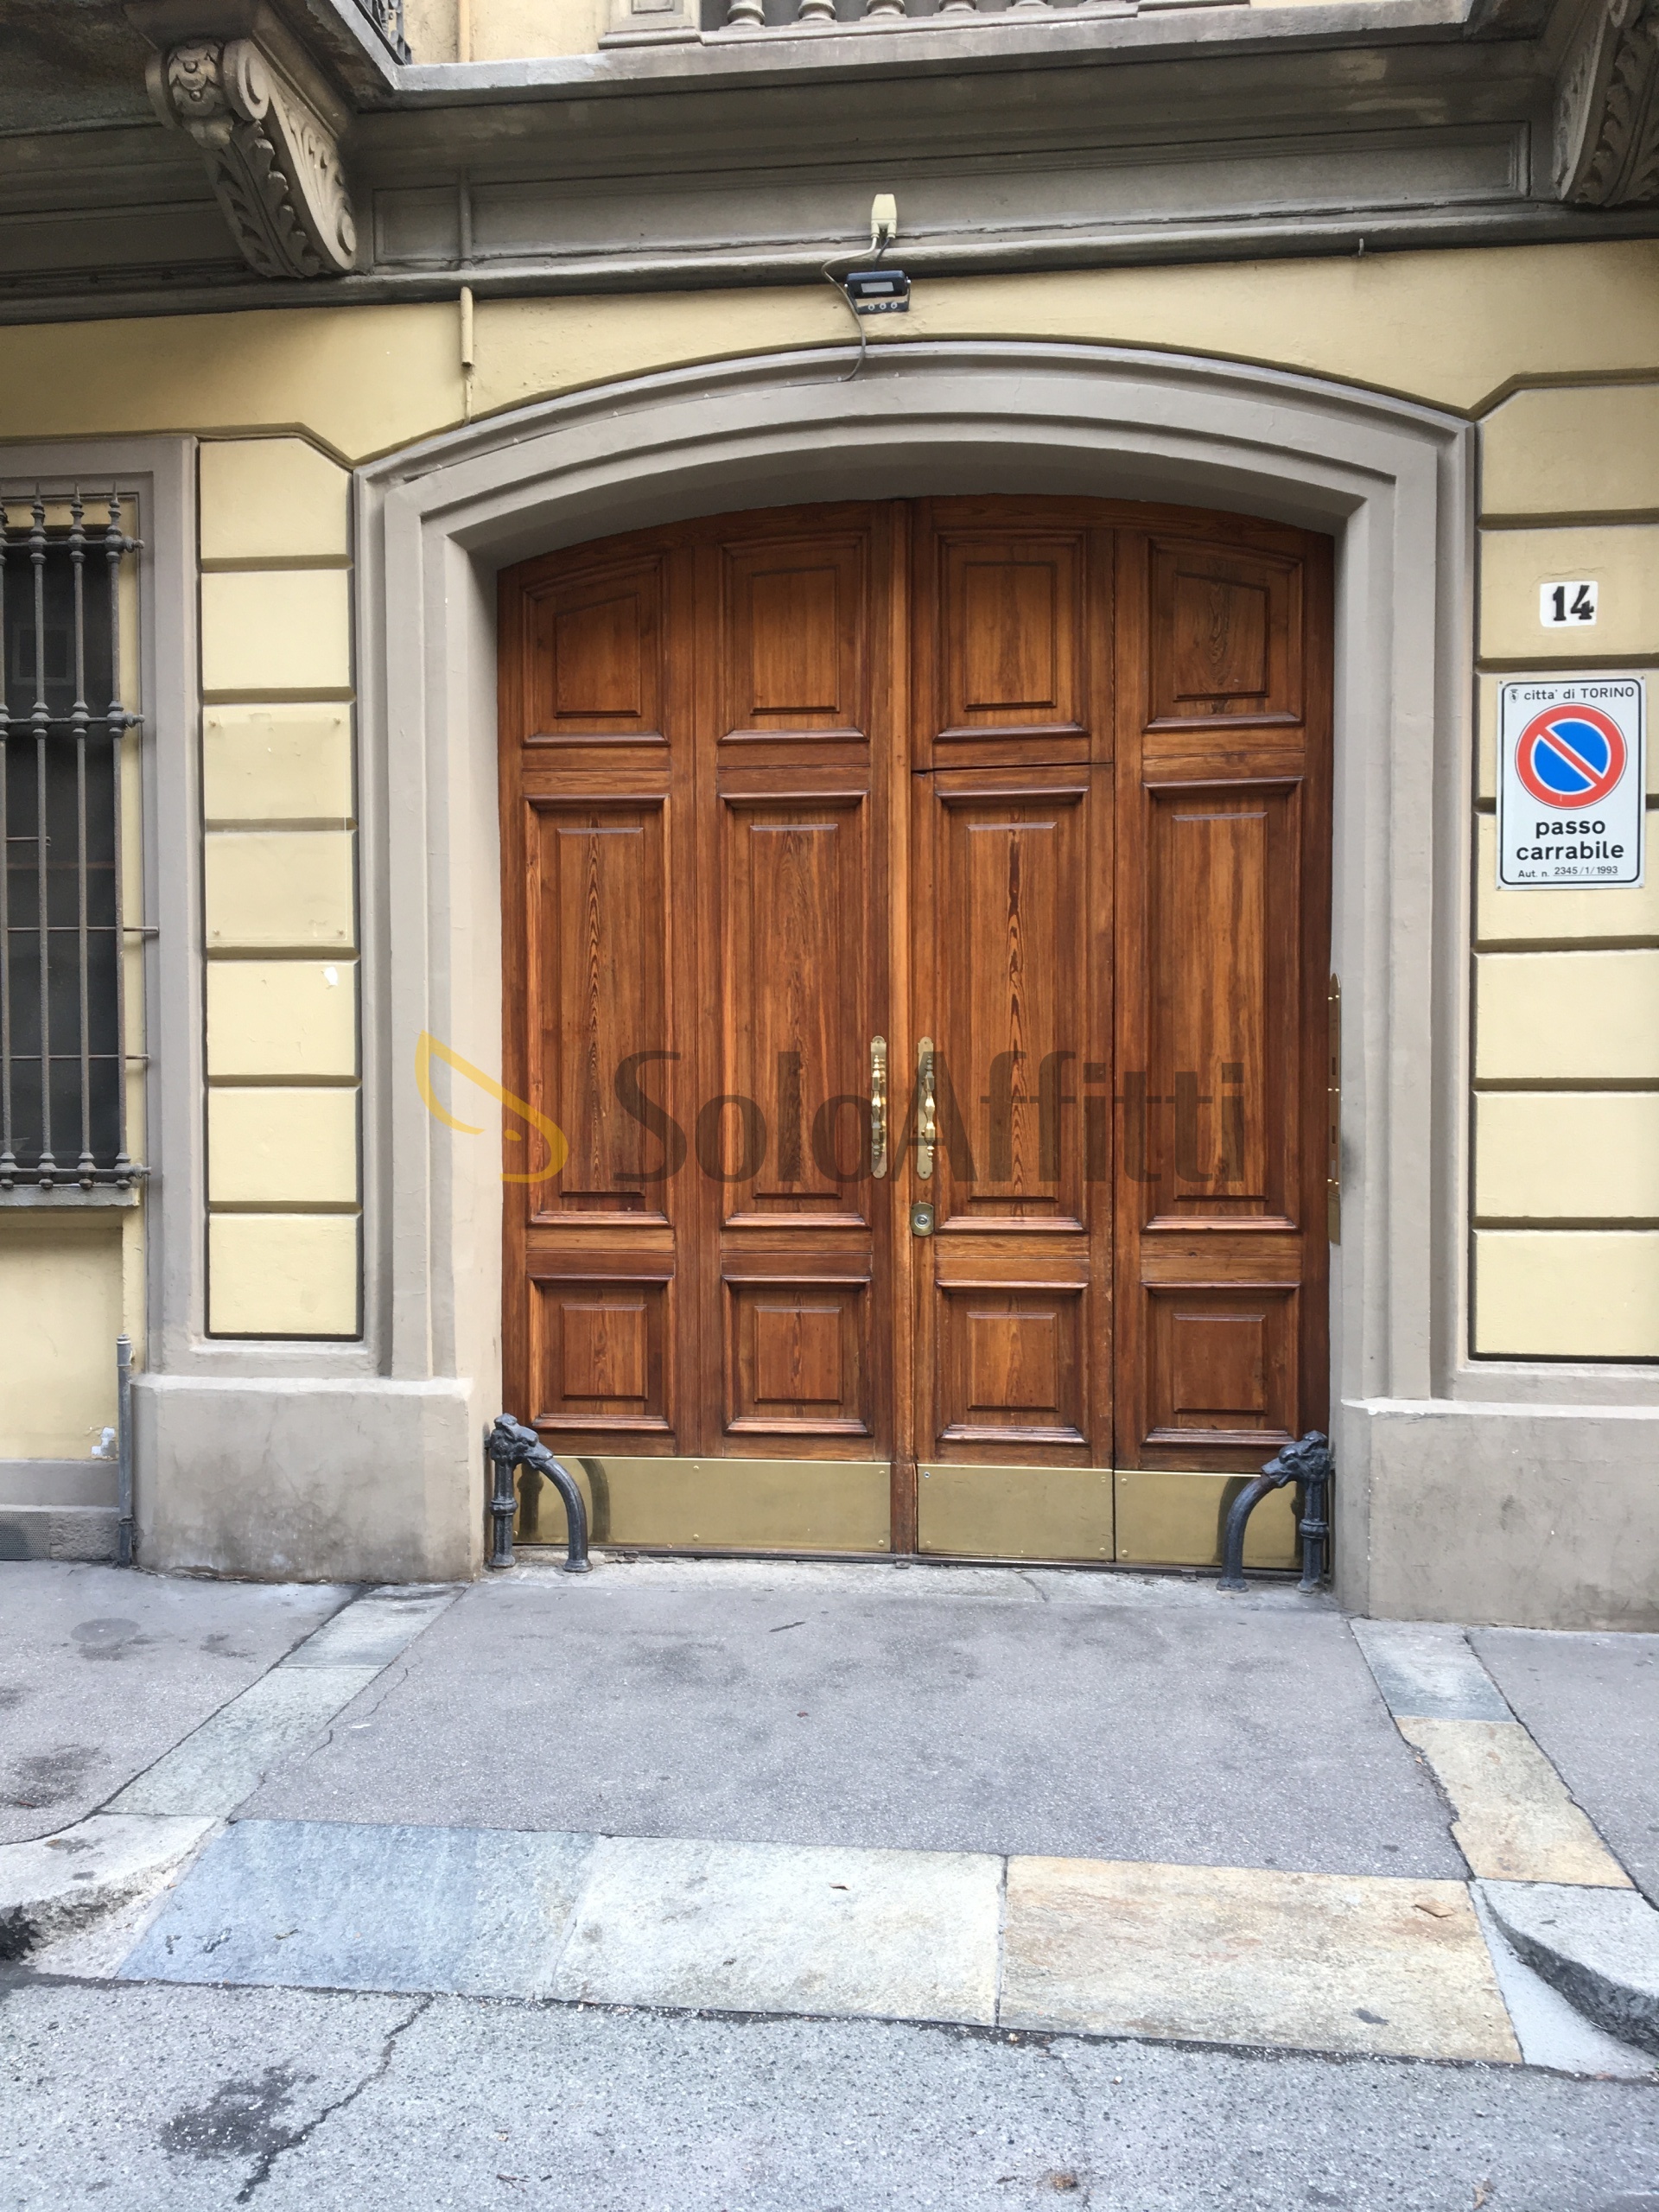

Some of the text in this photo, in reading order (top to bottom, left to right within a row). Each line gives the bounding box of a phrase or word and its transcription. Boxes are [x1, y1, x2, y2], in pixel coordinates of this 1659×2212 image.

[1552, 585, 1595, 621] 14
[1562, 689, 1575, 700] di
[1580, 686, 1635, 699] TORINO
[1535, 820, 1606, 839] passo
[1516, 841, 1624, 861] carrabile
[1517, 869, 1538, 878] Aut.
